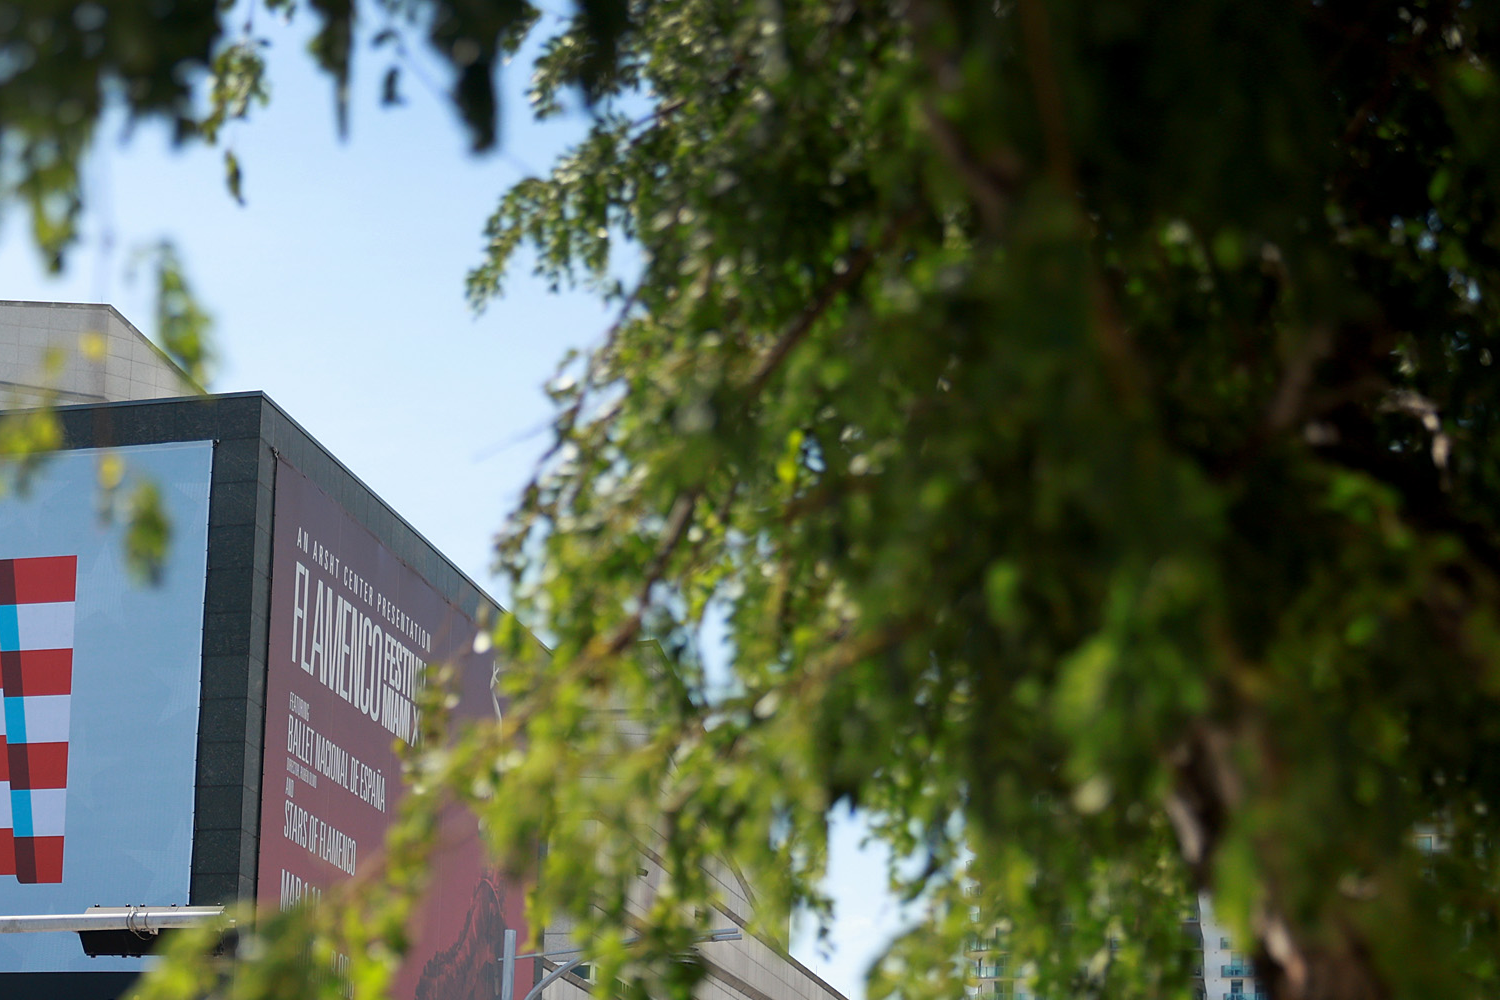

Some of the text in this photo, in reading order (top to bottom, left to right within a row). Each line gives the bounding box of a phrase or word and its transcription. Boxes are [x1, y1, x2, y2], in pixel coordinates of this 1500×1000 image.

[297, 527, 431, 653] AN ARSHT CENTER PRESENTATION
[291, 561, 383, 722] FLAMENCO
[287, 713, 315, 766] BALLET
[314, 732, 349, 790] NACIONAL
[350, 756, 360, 796] DE
[359, 762, 386, 813] ESPAÑA
[381, 683, 411, 744] MIAMI
[283, 799, 357, 877] STARS OF FLAMENCO
